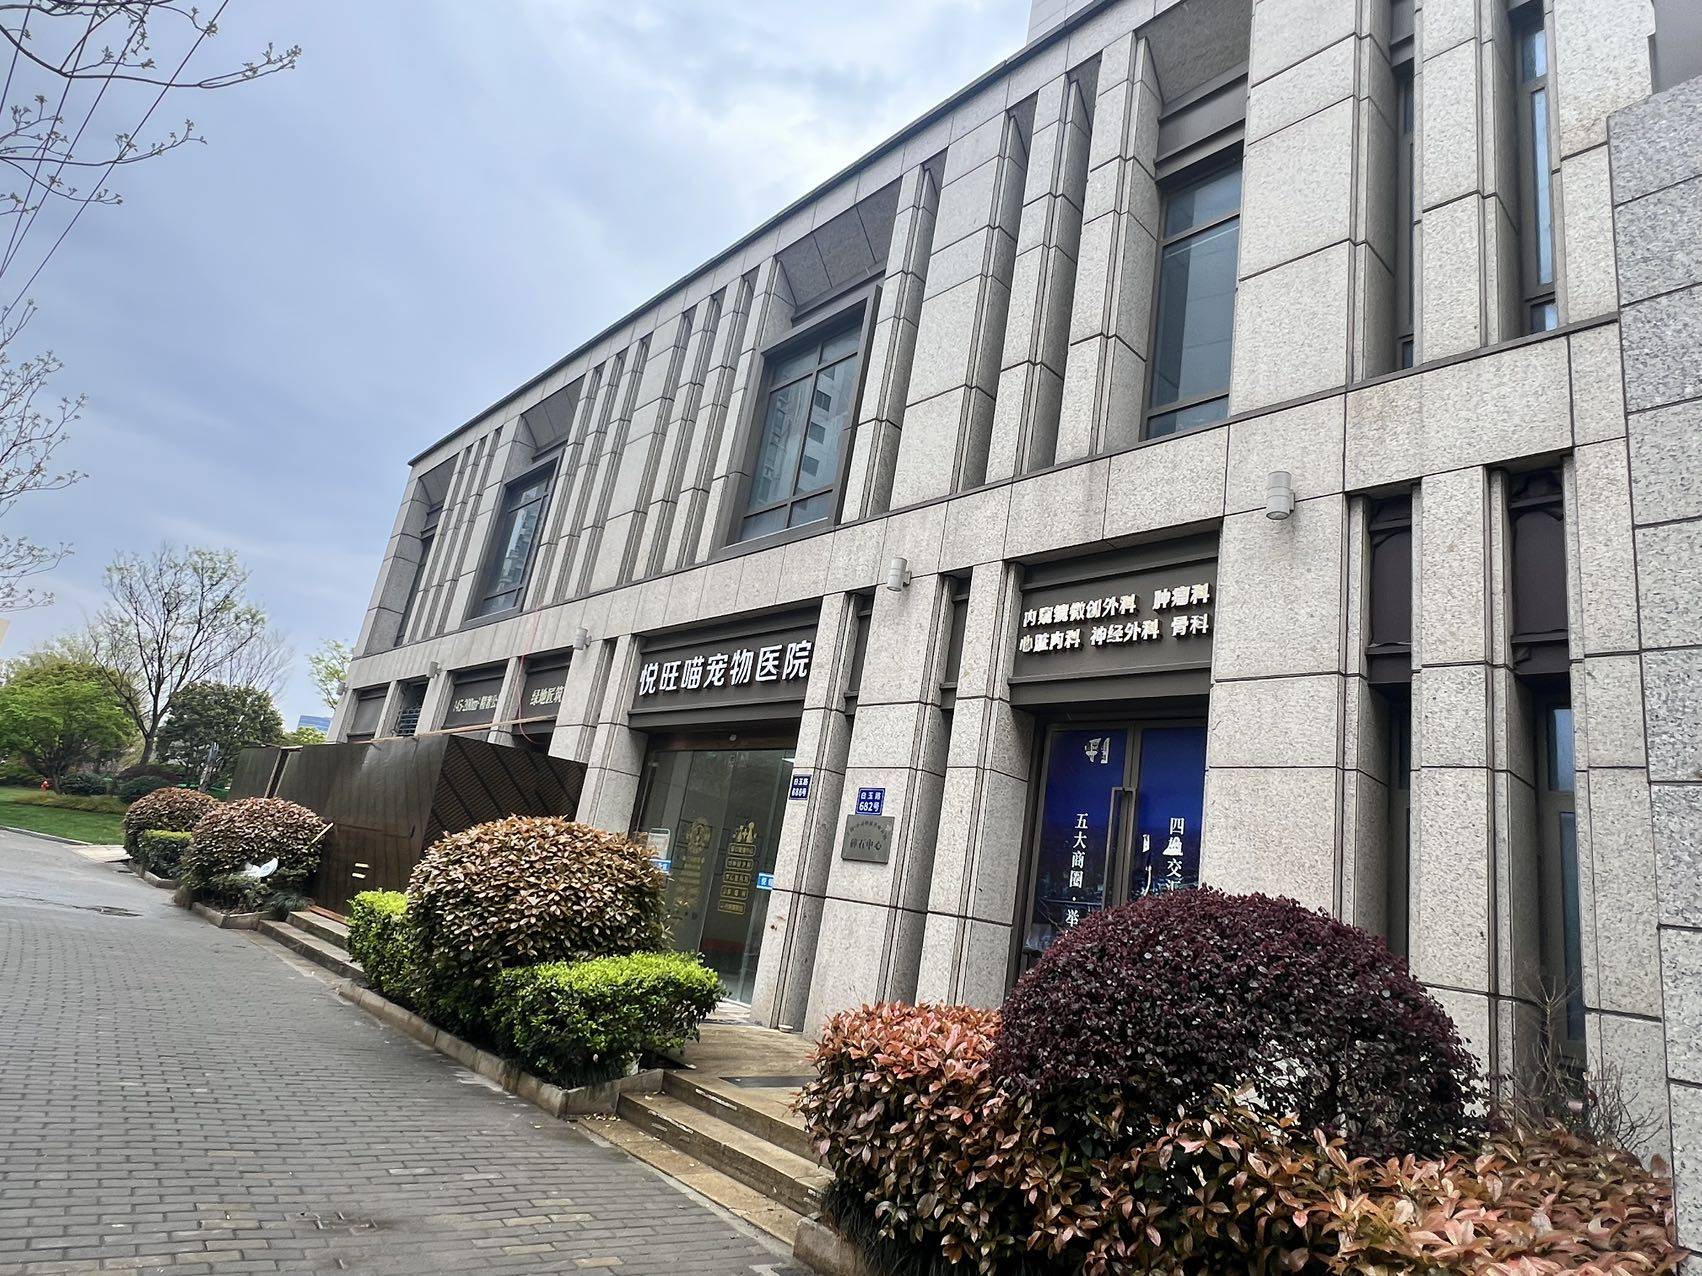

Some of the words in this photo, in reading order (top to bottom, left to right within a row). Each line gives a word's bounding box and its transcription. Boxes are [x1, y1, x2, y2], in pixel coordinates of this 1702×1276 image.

[1152, 583, 1210, 610] 肿瘤科
[1019, 629, 1081, 653] 心脏内科
[1090, 619, 1160, 646] 神经外科
[1171, 613, 1209, 637] 骨科
[638, 639, 813, 696] 悦旺喵宠物医院
[792, 777, 809, 786] 白玉路
[860, 791, 882, 800] 白玉路
[858, 801, 880, 813] 682号
